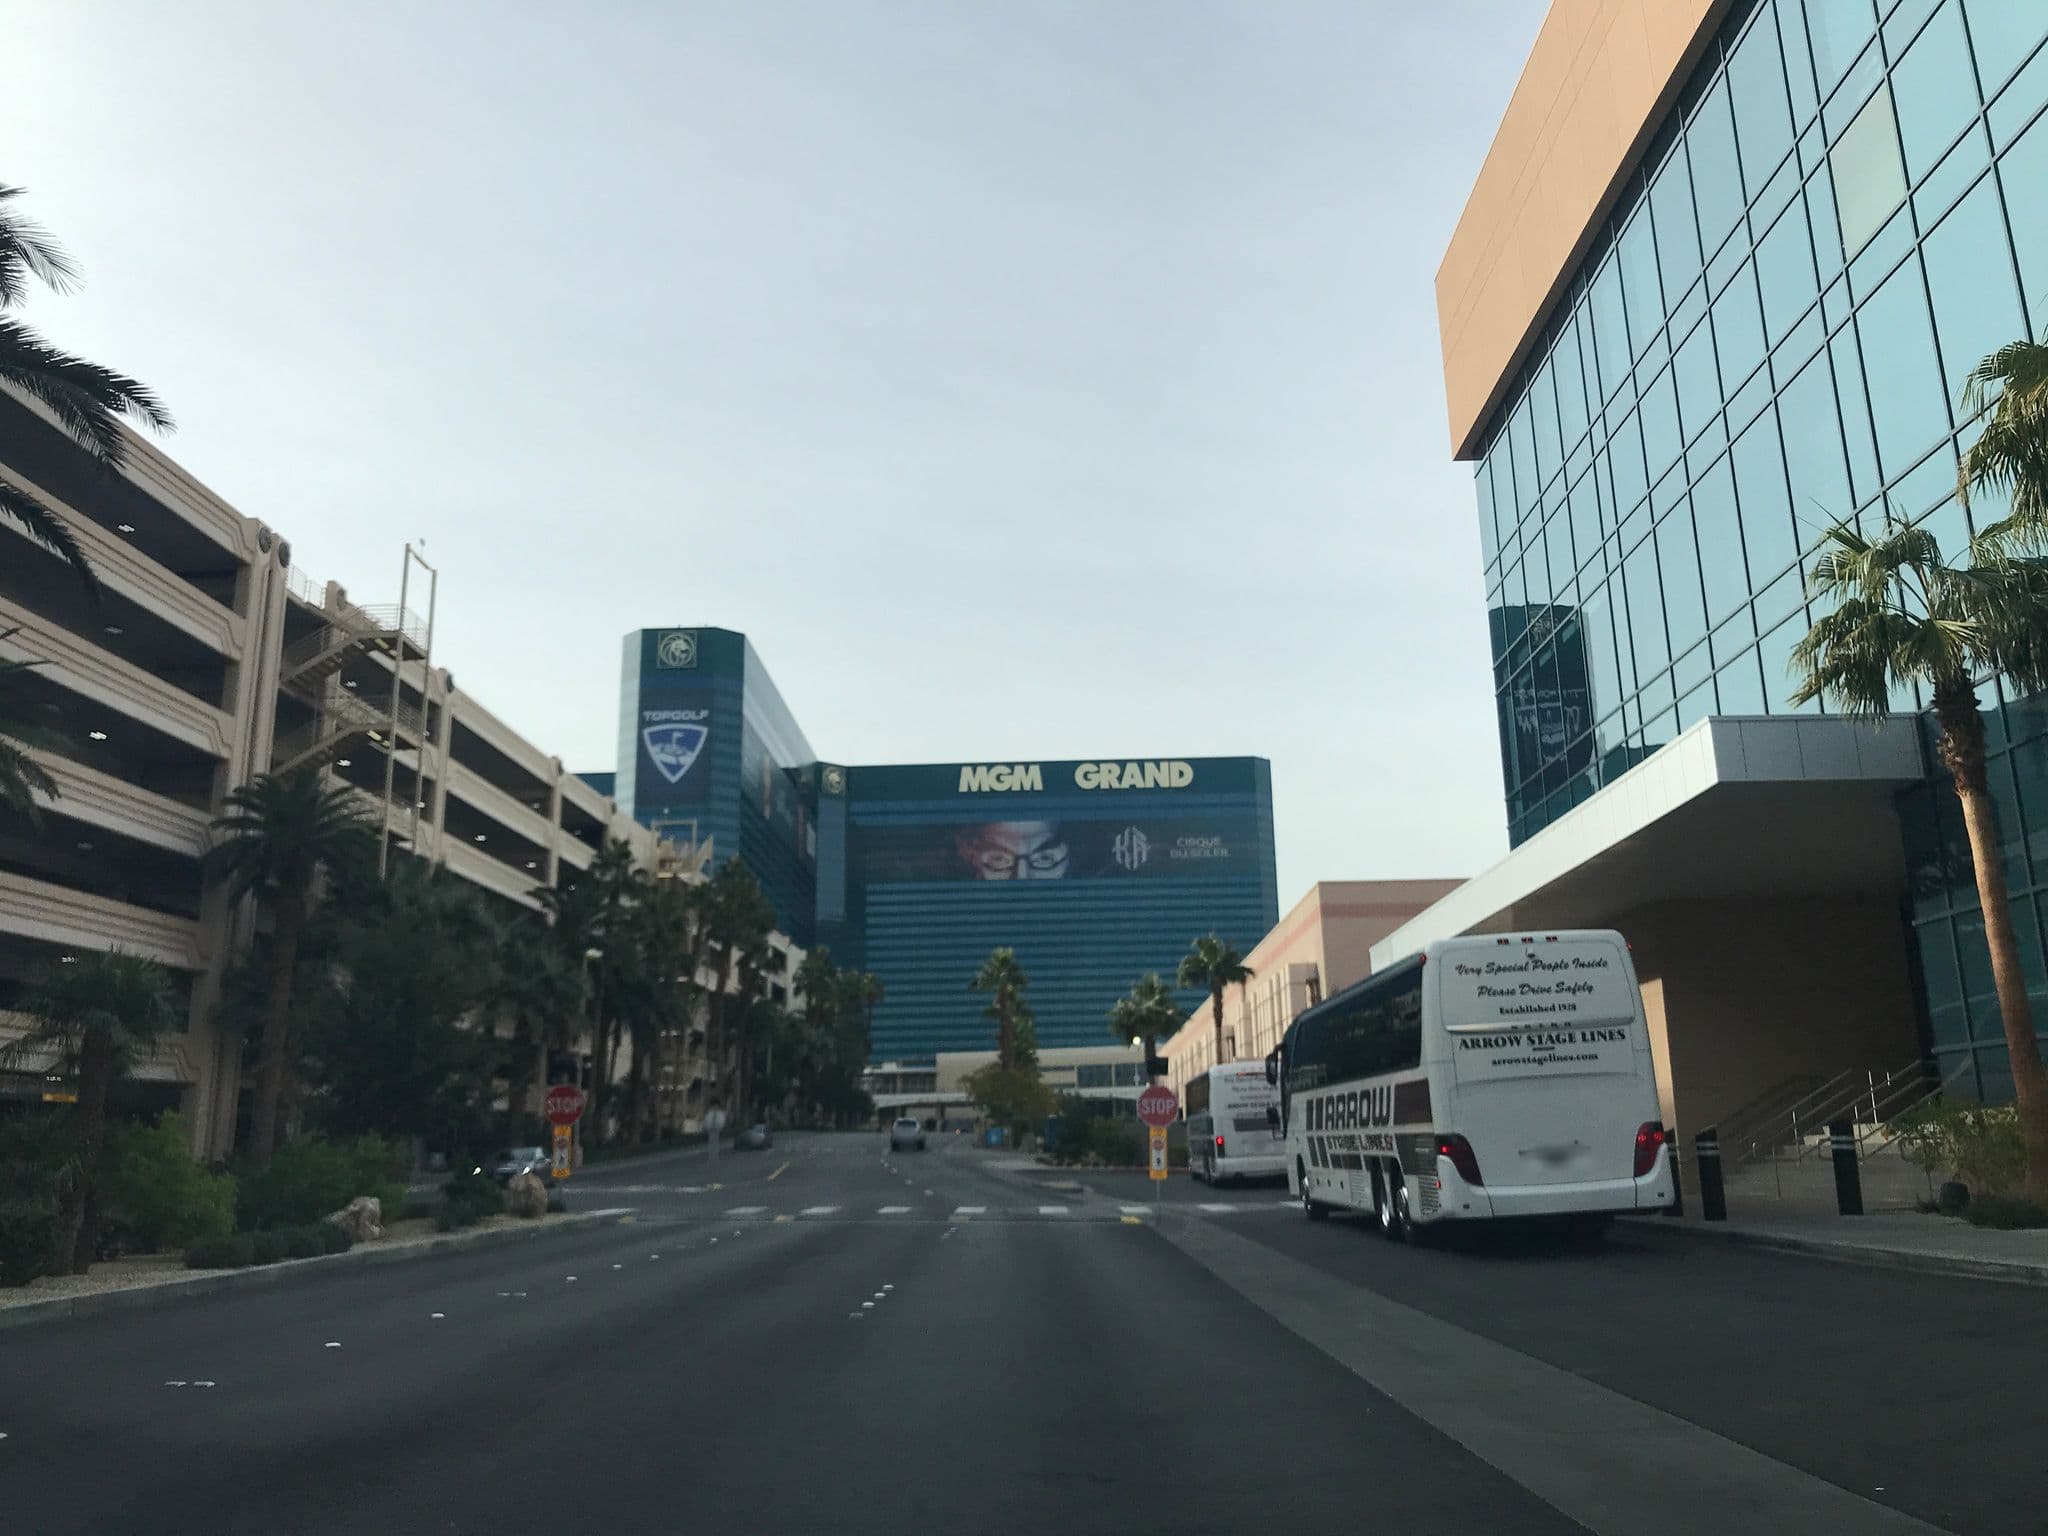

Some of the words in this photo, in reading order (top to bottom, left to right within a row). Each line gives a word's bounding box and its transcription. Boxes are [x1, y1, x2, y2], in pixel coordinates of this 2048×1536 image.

[643, 710, 709, 721] TOPGOLF
[959, 765, 1043, 792] MGM
[1074, 761, 1193, 789] GRAND
[1455, 964, 1482, 976] Very
[1485, 962, 1529, 975] Special
[1532, 959, 1570, 973] People
[1573, 957, 1608, 969] Inside
[1477, 985, 1516, 998] Please
[1519, 983, 1552, 996] Drive
[1555, 981, 1594, 996] Safely
[1499, 1005, 1556, 1015] Established
[1459, 1035, 1521, 1050] ARROW
[1527, 1032, 1577, 1047] STAGE
[1581, 1029, 1626, 1043] LINES
[1492, 1053, 1599, 1066] arrowstagelines.com
[545, 1096, 585, 1115] STOP
[1141, 1098, 1176, 1115] STOP
[1325, 1085, 1392, 1131] ARROW
